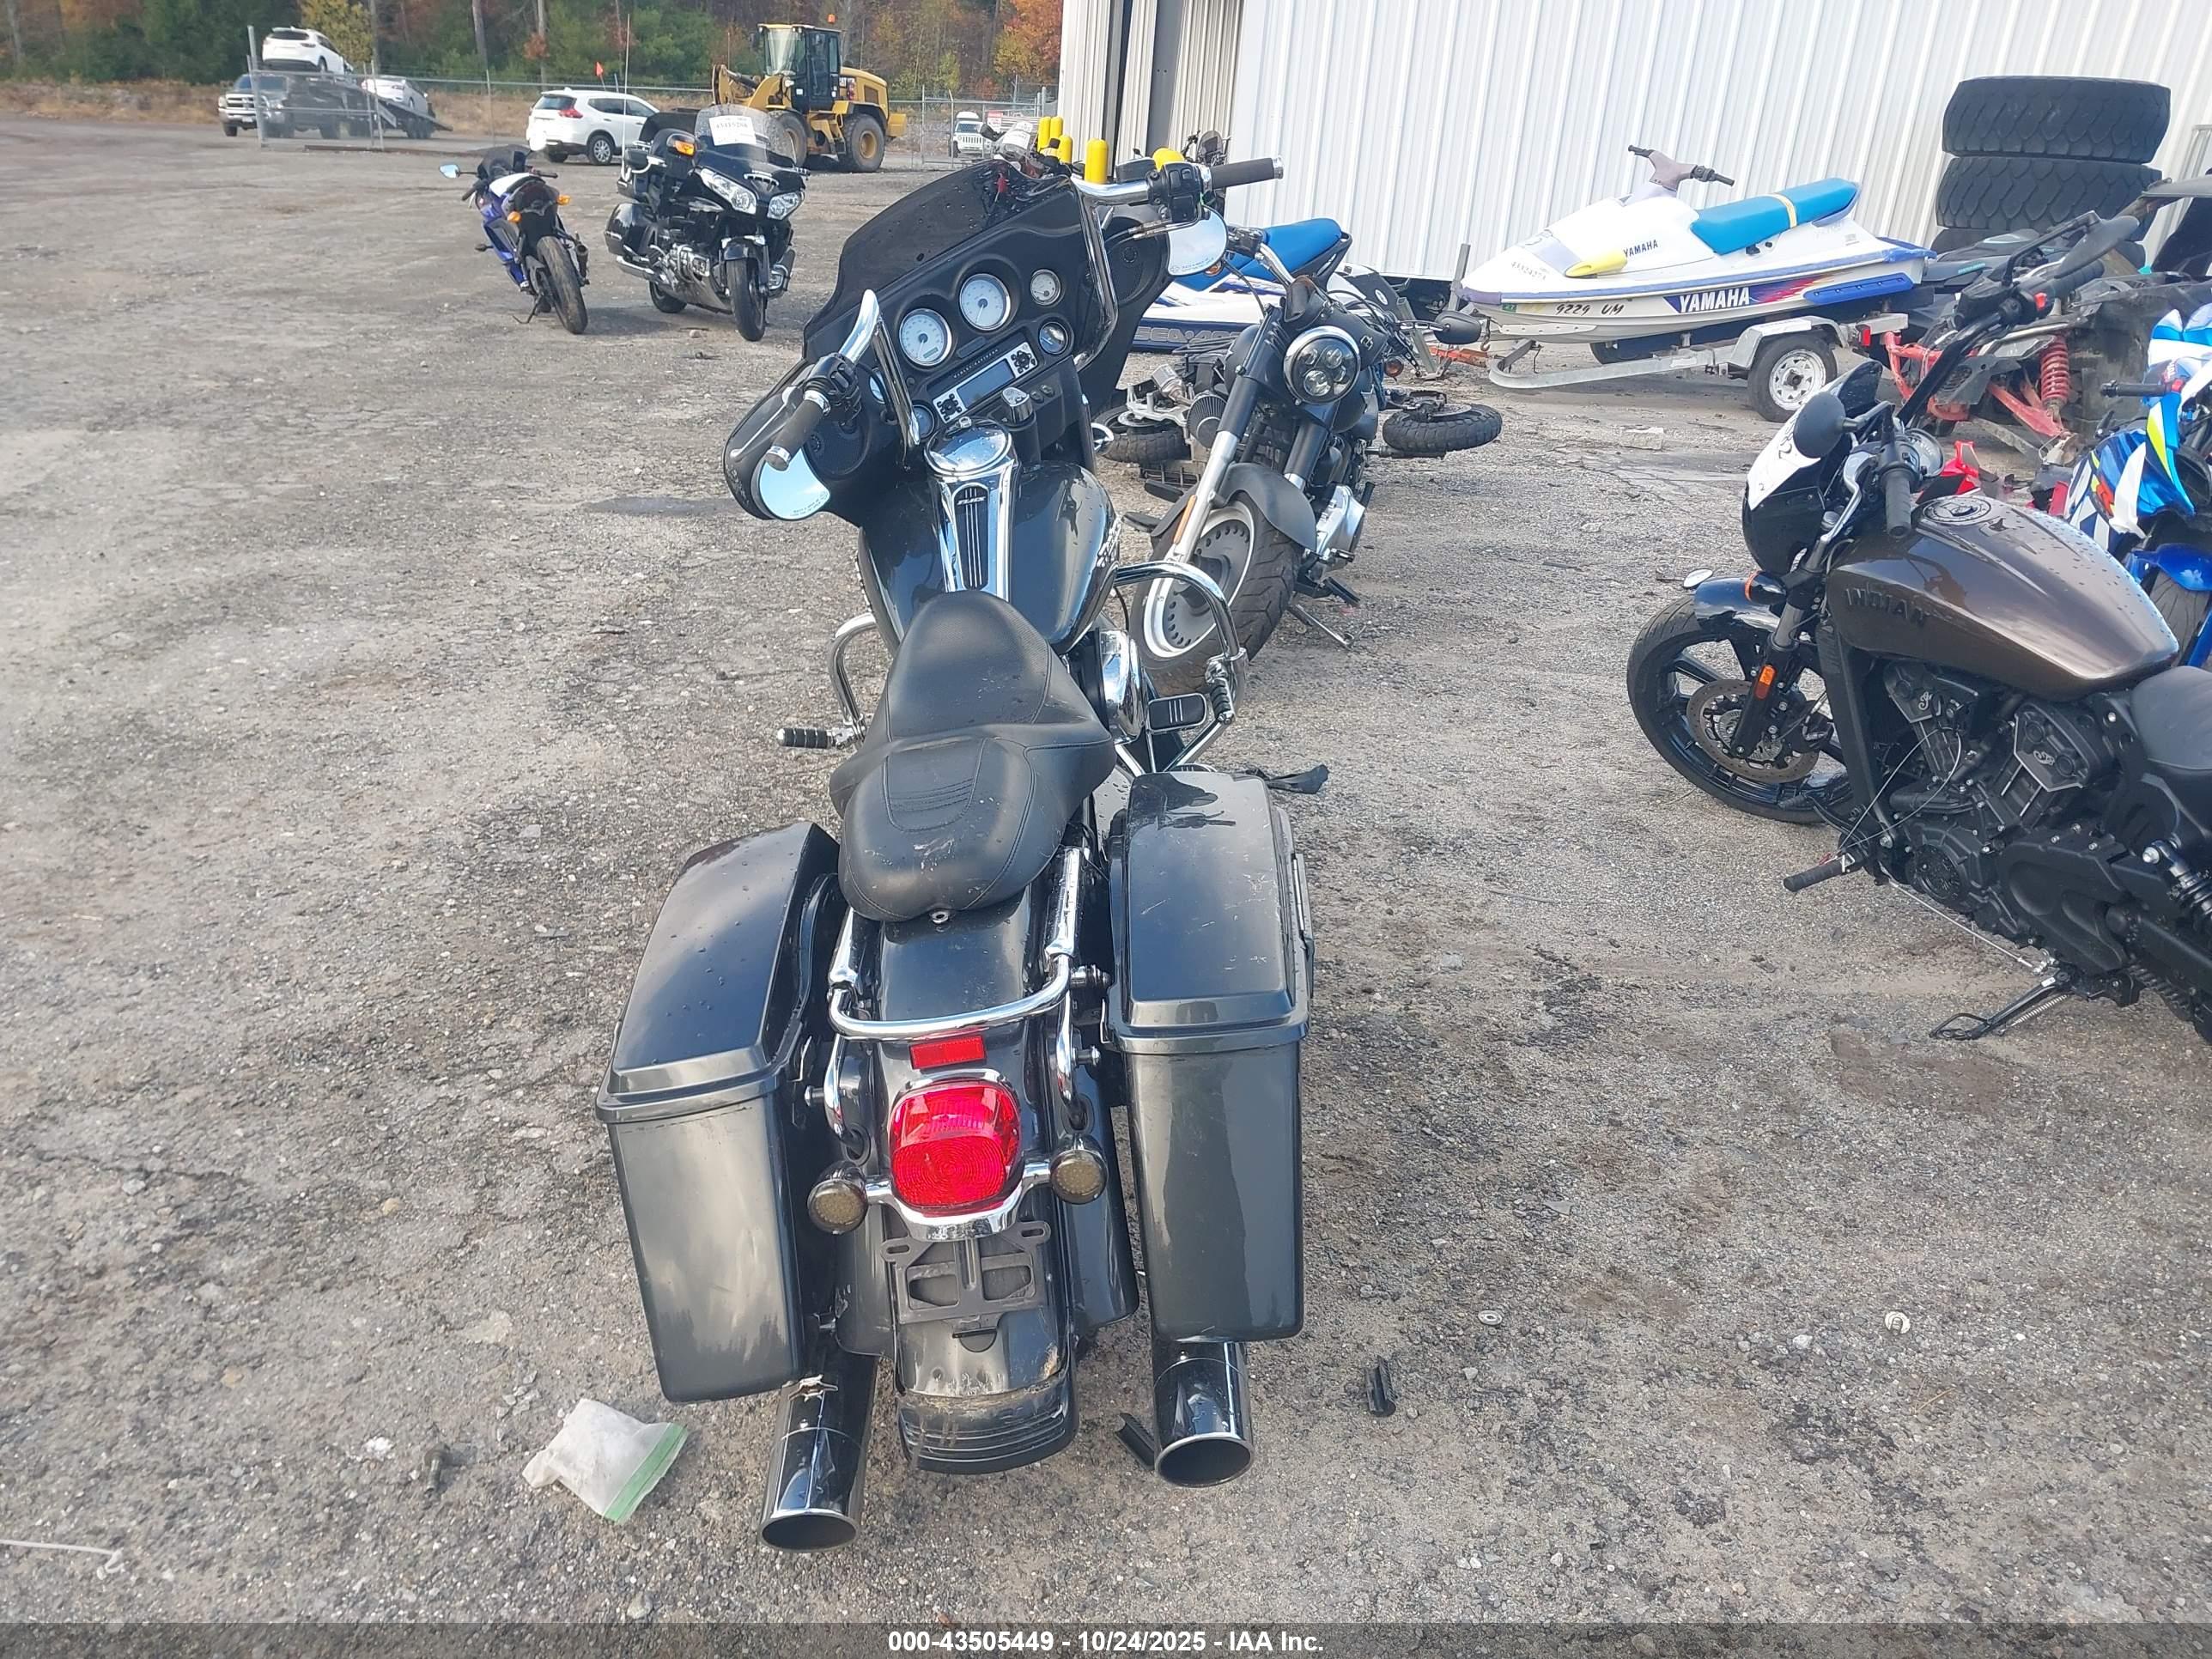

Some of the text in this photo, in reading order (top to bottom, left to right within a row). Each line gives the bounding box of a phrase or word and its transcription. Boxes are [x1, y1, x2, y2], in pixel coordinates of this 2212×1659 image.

[1623, 239, 1659, 258] YAMAHA
[1555, 303, 1590, 316] 9229
[1679, 287, 1750, 313] YAMAHA
